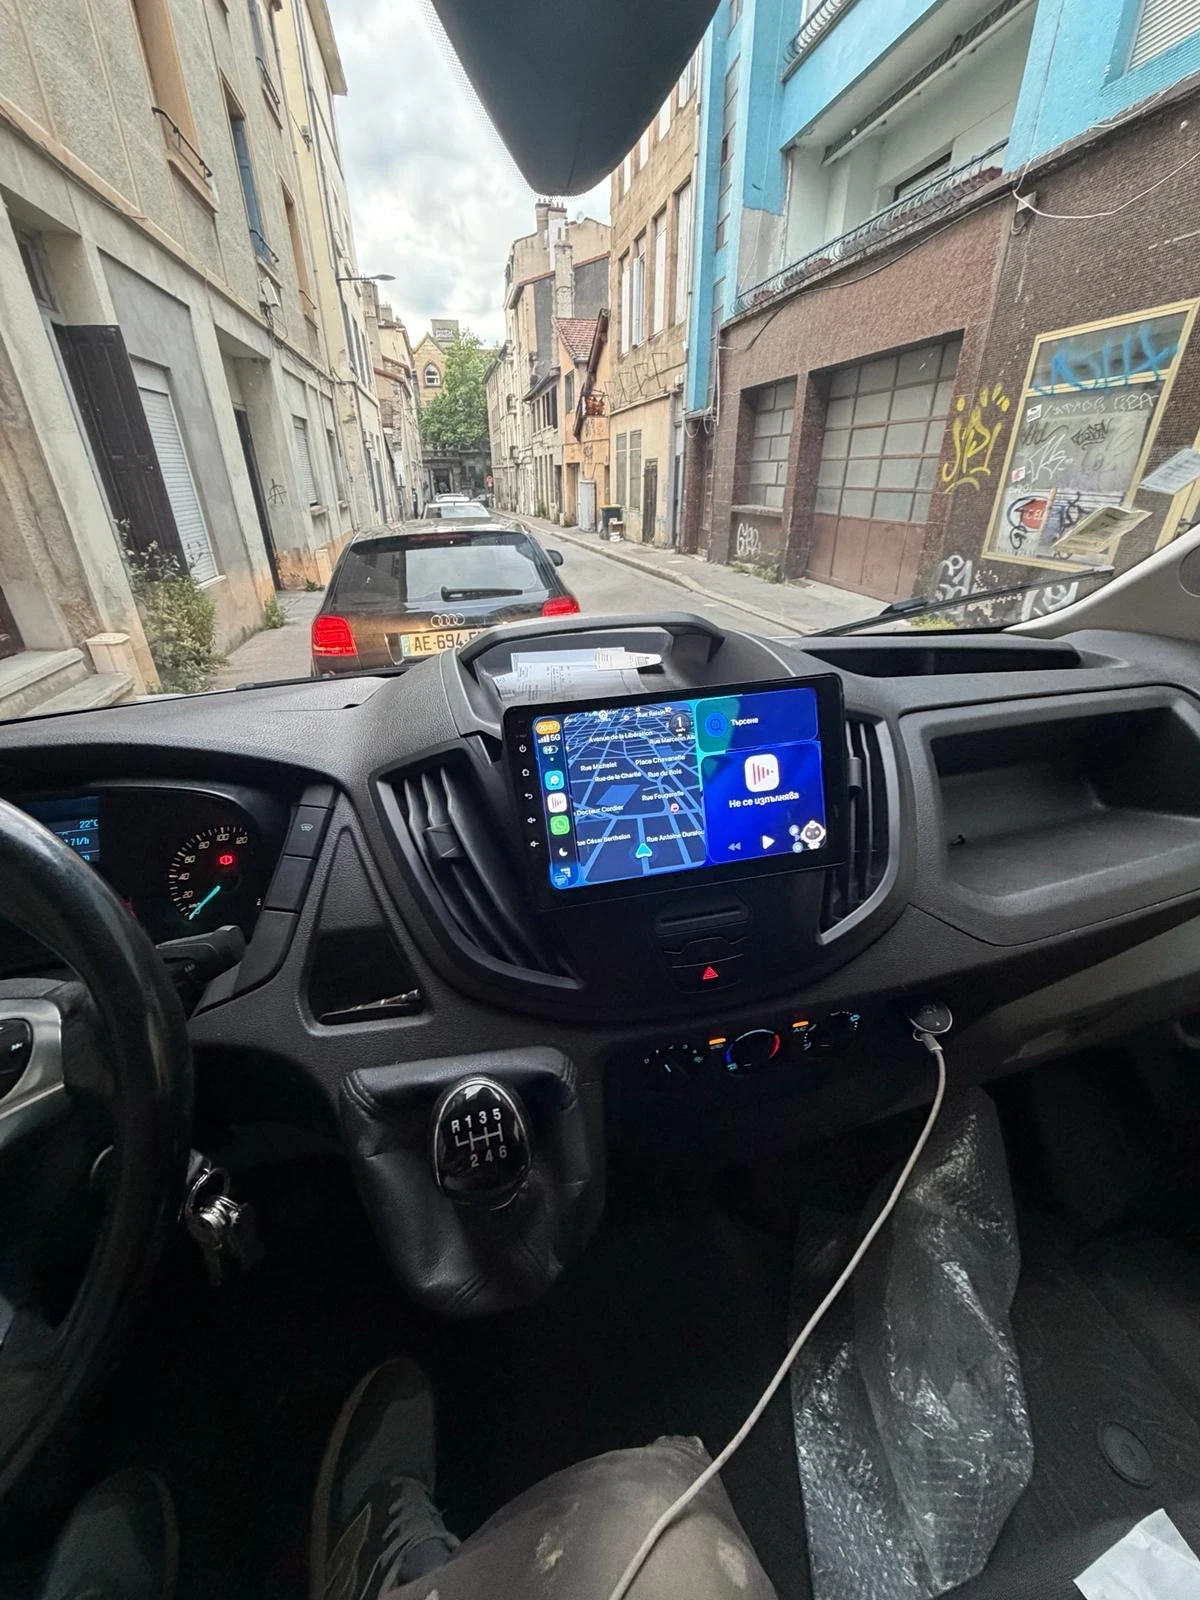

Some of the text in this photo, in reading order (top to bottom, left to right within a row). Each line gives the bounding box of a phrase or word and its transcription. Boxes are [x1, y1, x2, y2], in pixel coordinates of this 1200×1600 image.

[676, 716, 682, 728] 1
[730, 717, 759, 726] Търсене
[588, 735, 610, 743] Avenue
[624, 730, 653, 740] Libération
[652, 754, 686, 764] Chavanelle
[592, 761, 617, 770] Michelet
[620, 771, 642, 780] Charité
[660, 769, 668, 777] du
[667, 768, 682, 776] Bois
[653, 790, 685, 800] Fougerolle
[728, 791, 800, 809] Не се изпълнява
[576, 804, 624, 816] Docteur Cordier
[79, 819, 99, 829] 22°C
[585, 835, 603, 845] César
[602, 833, 631, 843] Bertholon
[658, 833, 682, 842] Antoine
[184, 856, 196, 864] 60
[179, 873, 190, 881] 40
[183, 890, 194, 899] 20
[451, 1107, 501, 1134] R 1 3 5
[470, 1145, 507, 1168] 2 4 6
